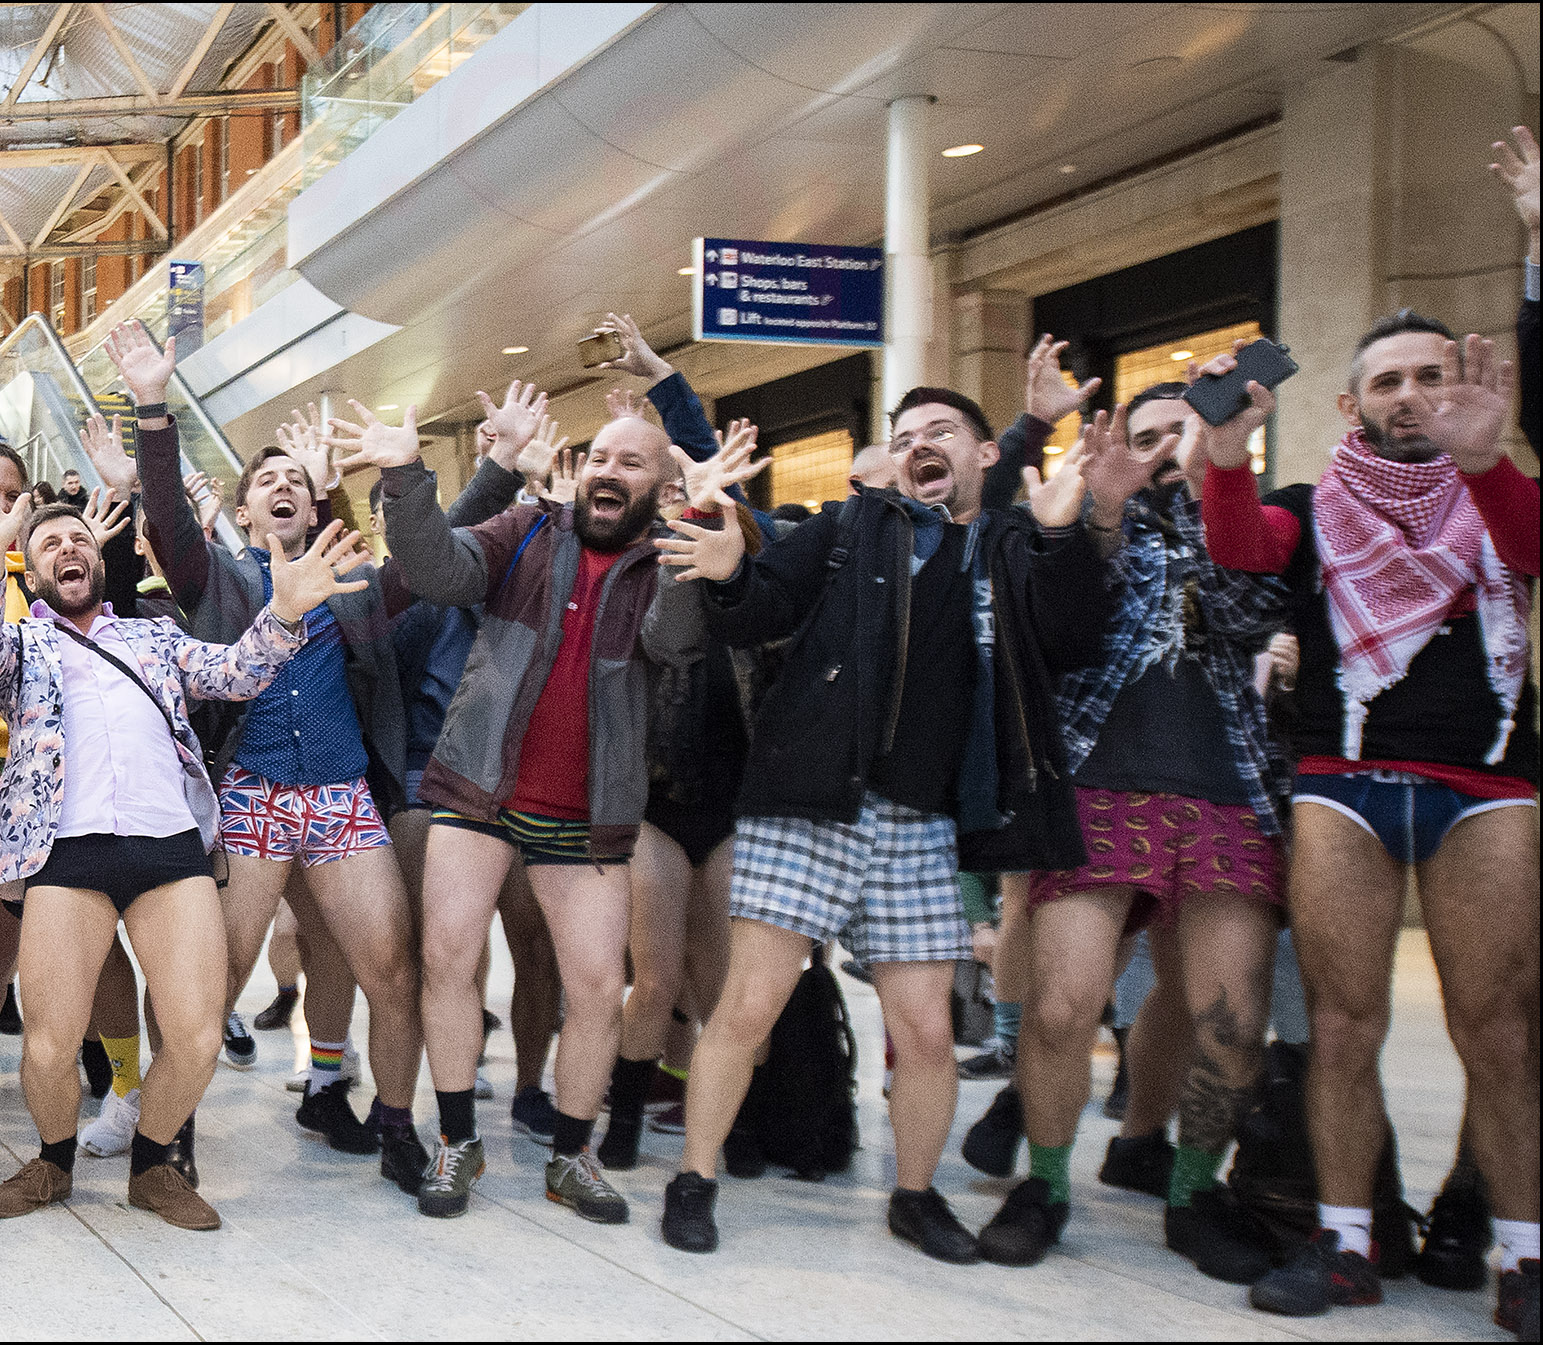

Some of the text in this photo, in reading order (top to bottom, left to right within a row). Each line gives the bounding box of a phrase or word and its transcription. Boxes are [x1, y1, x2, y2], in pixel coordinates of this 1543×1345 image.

[741, 252, 869, 271] Waterloo East Station
[781, 277, 808, 291] bars
[740, 290, 820, 306] & restaurants
[740, 311, 762, 325] Lift
